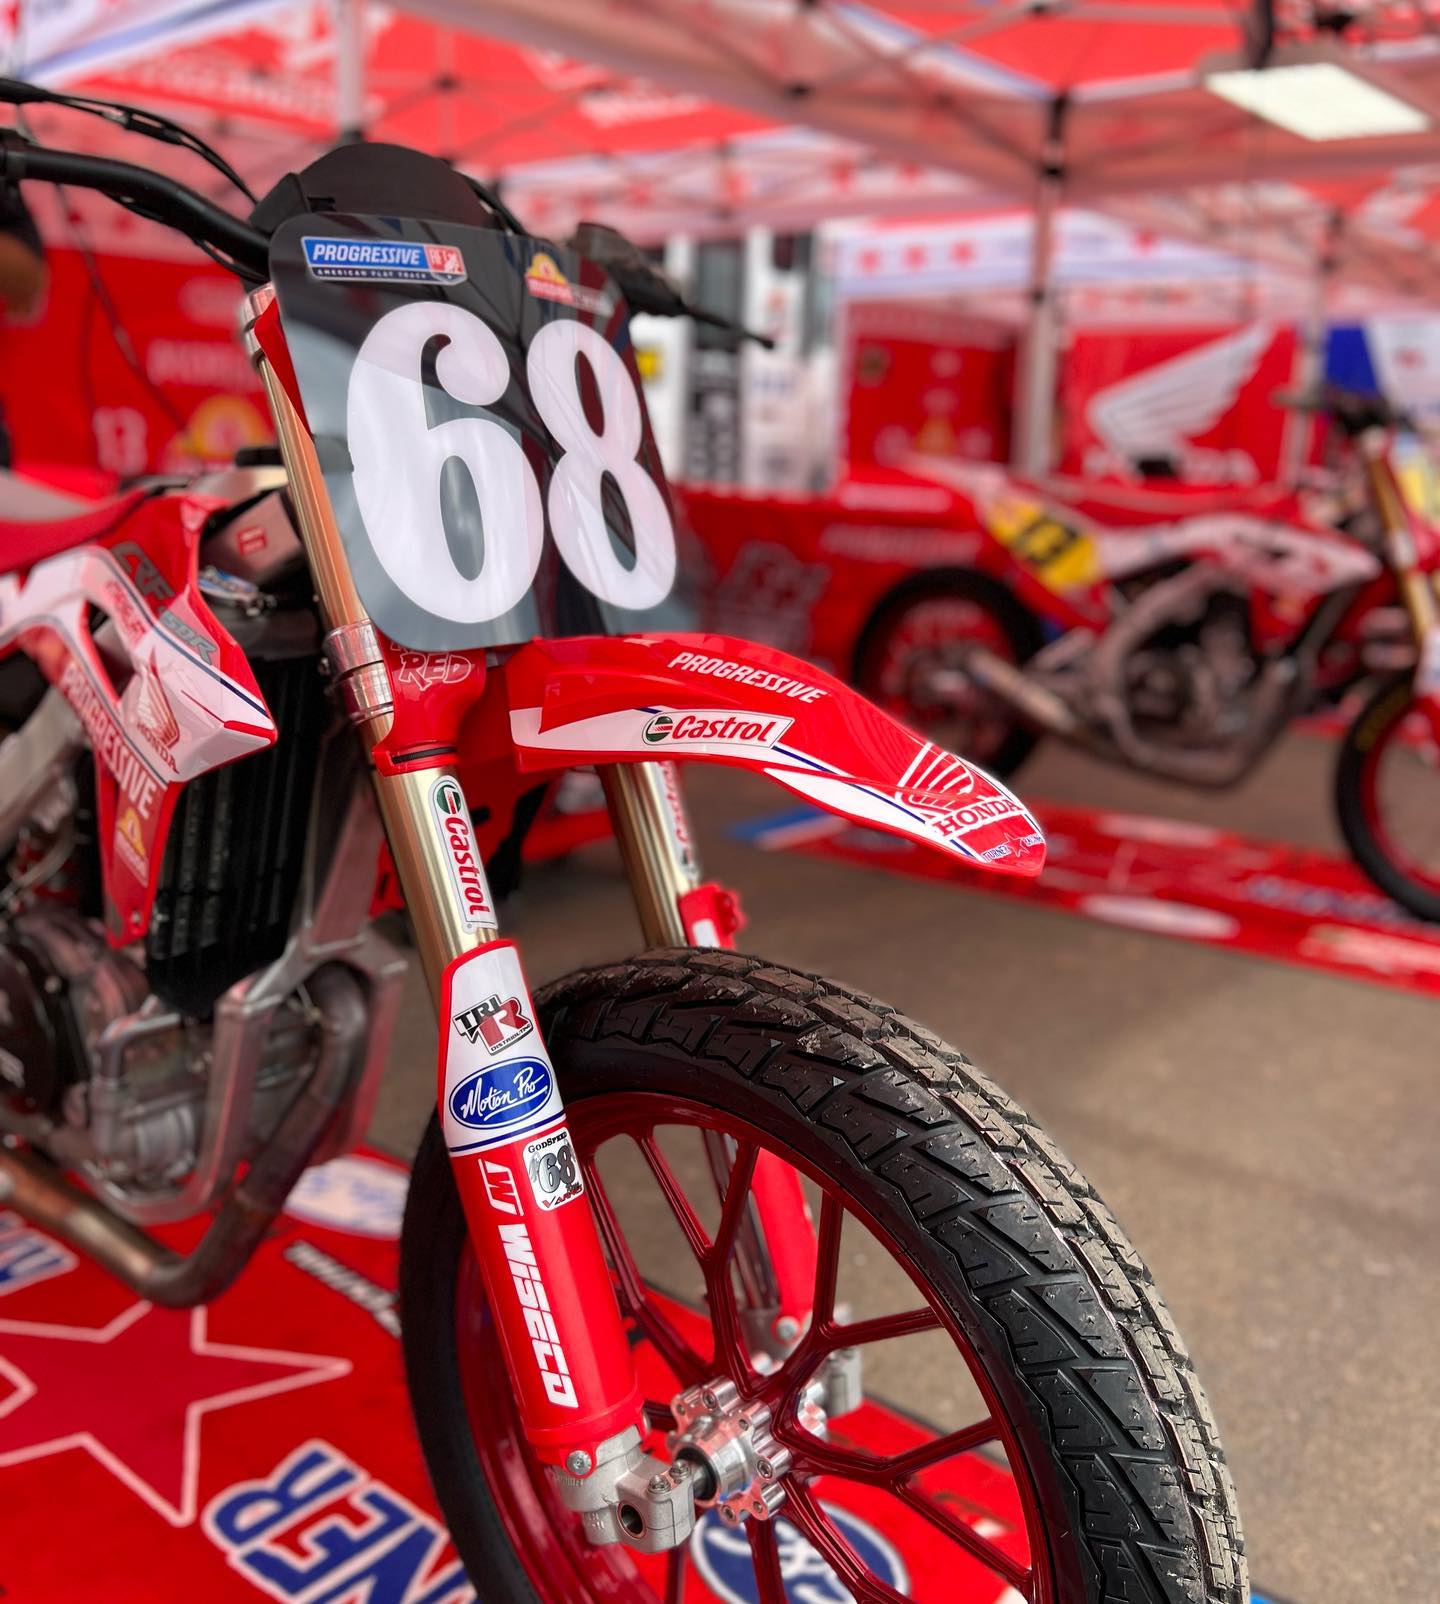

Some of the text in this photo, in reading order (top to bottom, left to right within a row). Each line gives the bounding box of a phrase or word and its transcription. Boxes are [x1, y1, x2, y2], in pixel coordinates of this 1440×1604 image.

[312, 243, 422, 265] PROGRESSIVE
[317, 269, 427, 280] AMERICAN FLAT TRACK
[347, 302, 676, 624] 68
[111, 540, 176, 600] CRF
[398, 651, 472, 692] RED
[667, 651, 829, 704] PROGRESSIVE
[60, 660, 157, 821] PROGRESSIVE
[137, 720, 181, 775] HONDA
[671, 715, 777, 742] Castrol
[932, 798, 1024, 837] HONDA
[444, 816, 491, 916] Castrol
[454, 996, 501, 1030] TRI
[460, 1066, 545, 1119] Motion Pro
[538, 1145, 576, 1194] 68
